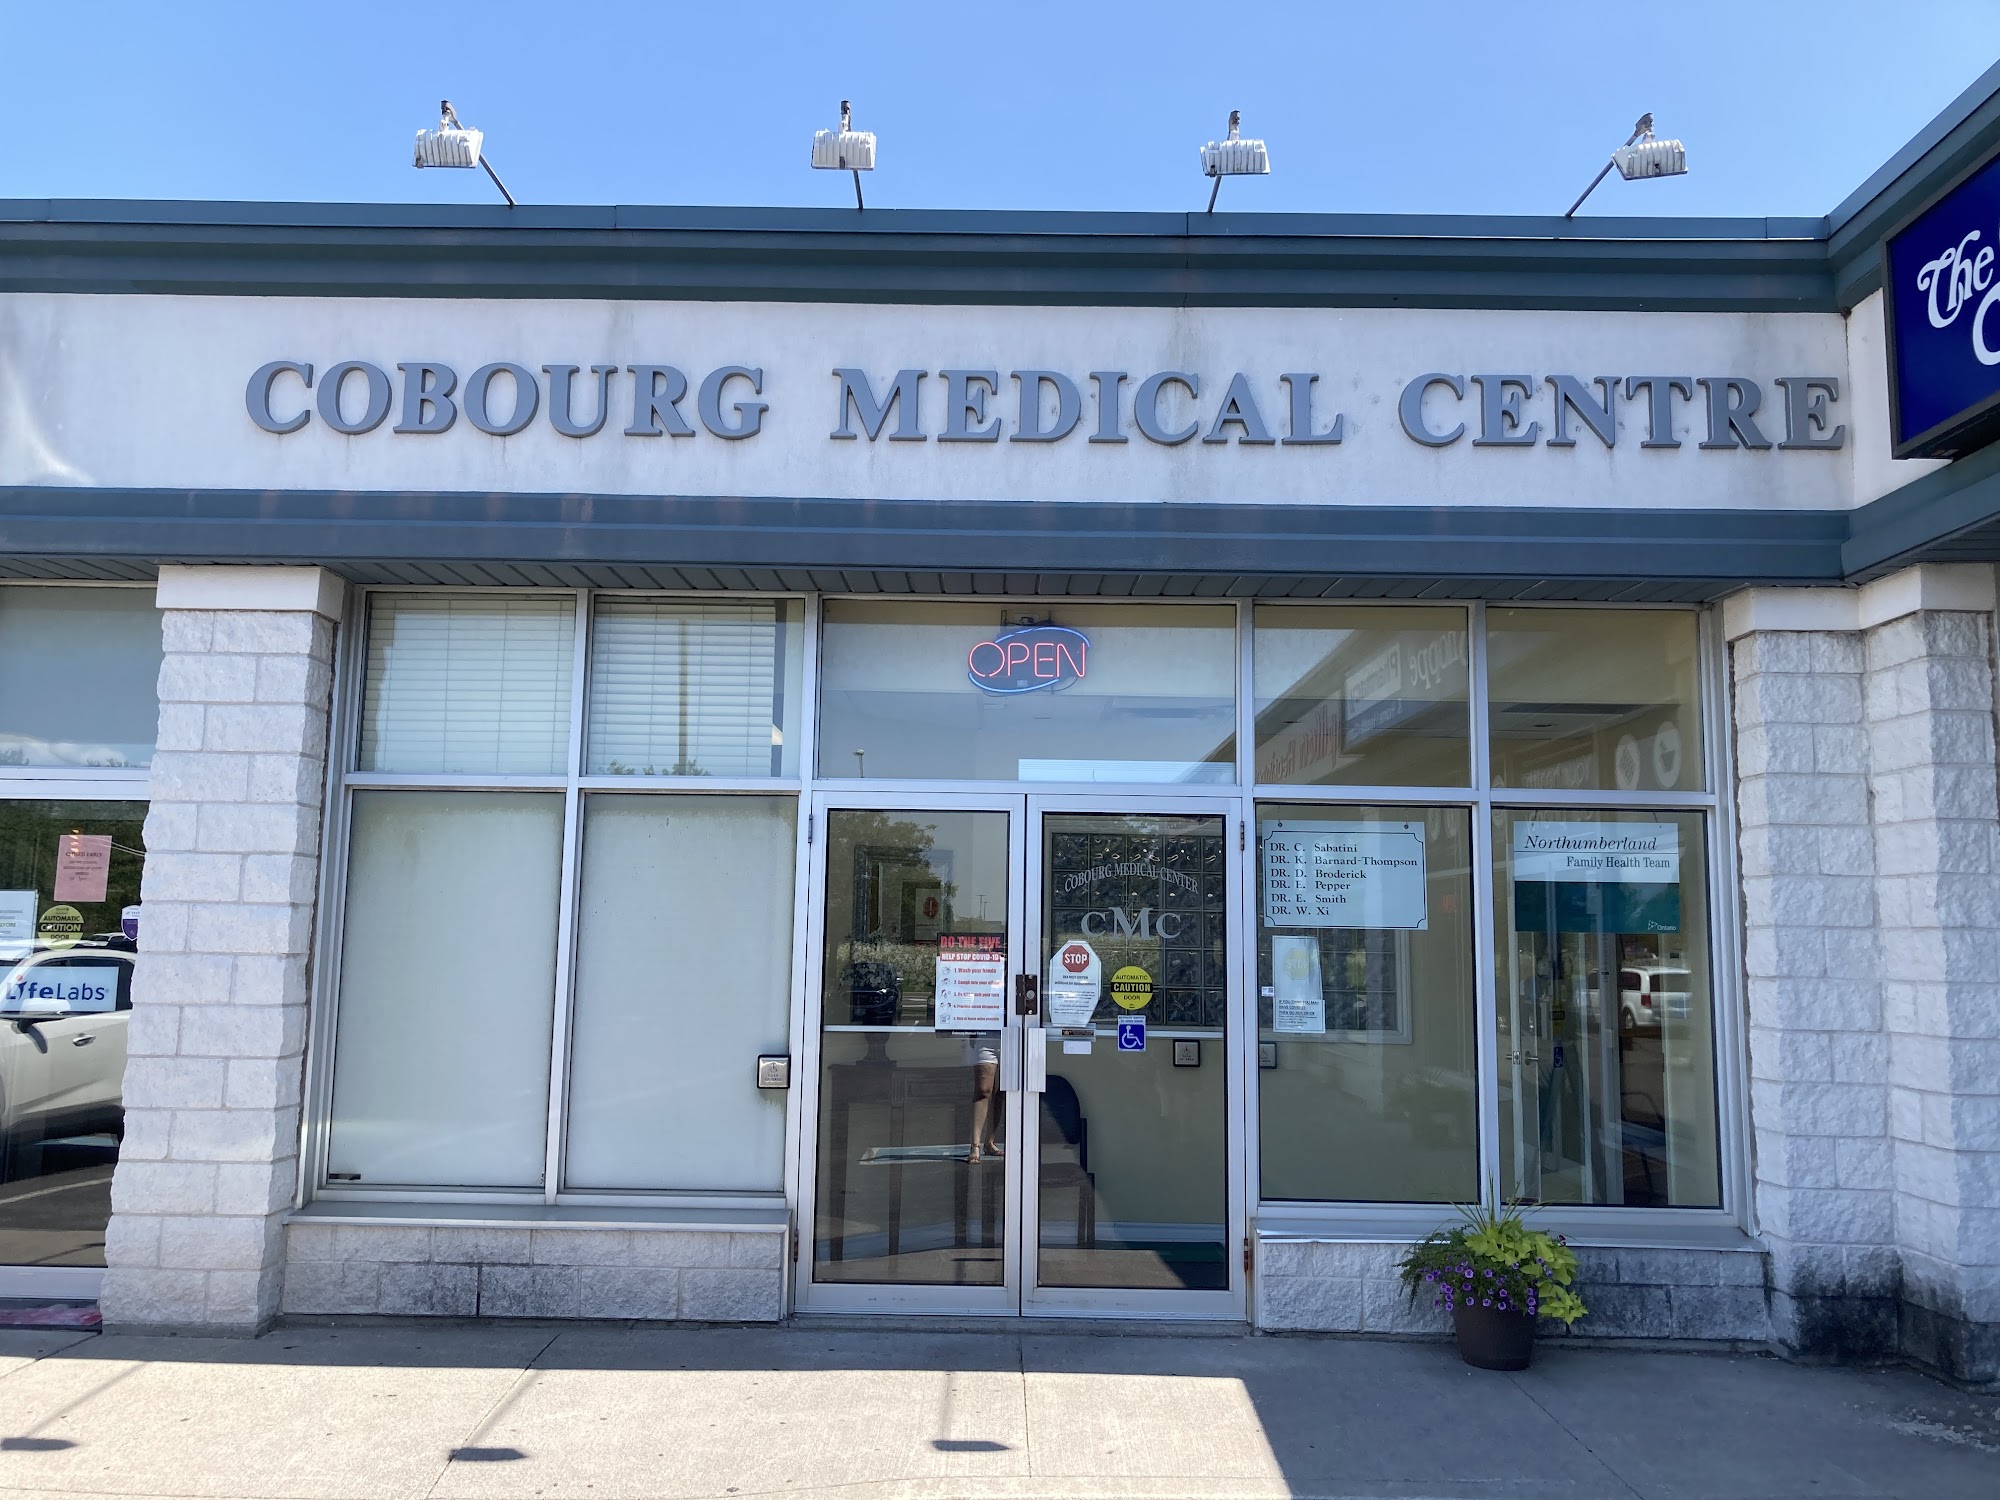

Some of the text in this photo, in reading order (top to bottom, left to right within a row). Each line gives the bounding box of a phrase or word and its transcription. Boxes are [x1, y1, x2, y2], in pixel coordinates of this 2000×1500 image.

[1916, 229, 1995, 329] The
[245, 359, 1847, 451] COBOURG MEDICAL CENTRE
[968, 641, 1086, 678] OPEN
[1270, 843, 1358, 853] DR. C. Sabatini
[1524, 835, 1658, 851] Northumberland
[1270, 855, 1418, 868] DR. K. Barnard-Thompson
[1566, 856, 1670, 870] Family Health Team
[1064, 862, 1199, 895] COBOURG MEDICAL CENTER
[1271, 868, 1367, 879] DR. D. Broderick
[1271, 880, 1351, 892] DR. E. Pepper
[1271, 894, 1347, 904] DR. E. Smith
[1272, 906, 1330, 916] DR. W. Xi
[1080, 906, 1182, 941] CMC
[940, 935, 955, 948] DO
[941, 953, 999, 961] HELP STOP COVID-19
[1064, 953, 1088, 965] STOP
[5, 974, 105, 1001] LifeLabs
[1113, 983, 1151, 992] CAUTION
